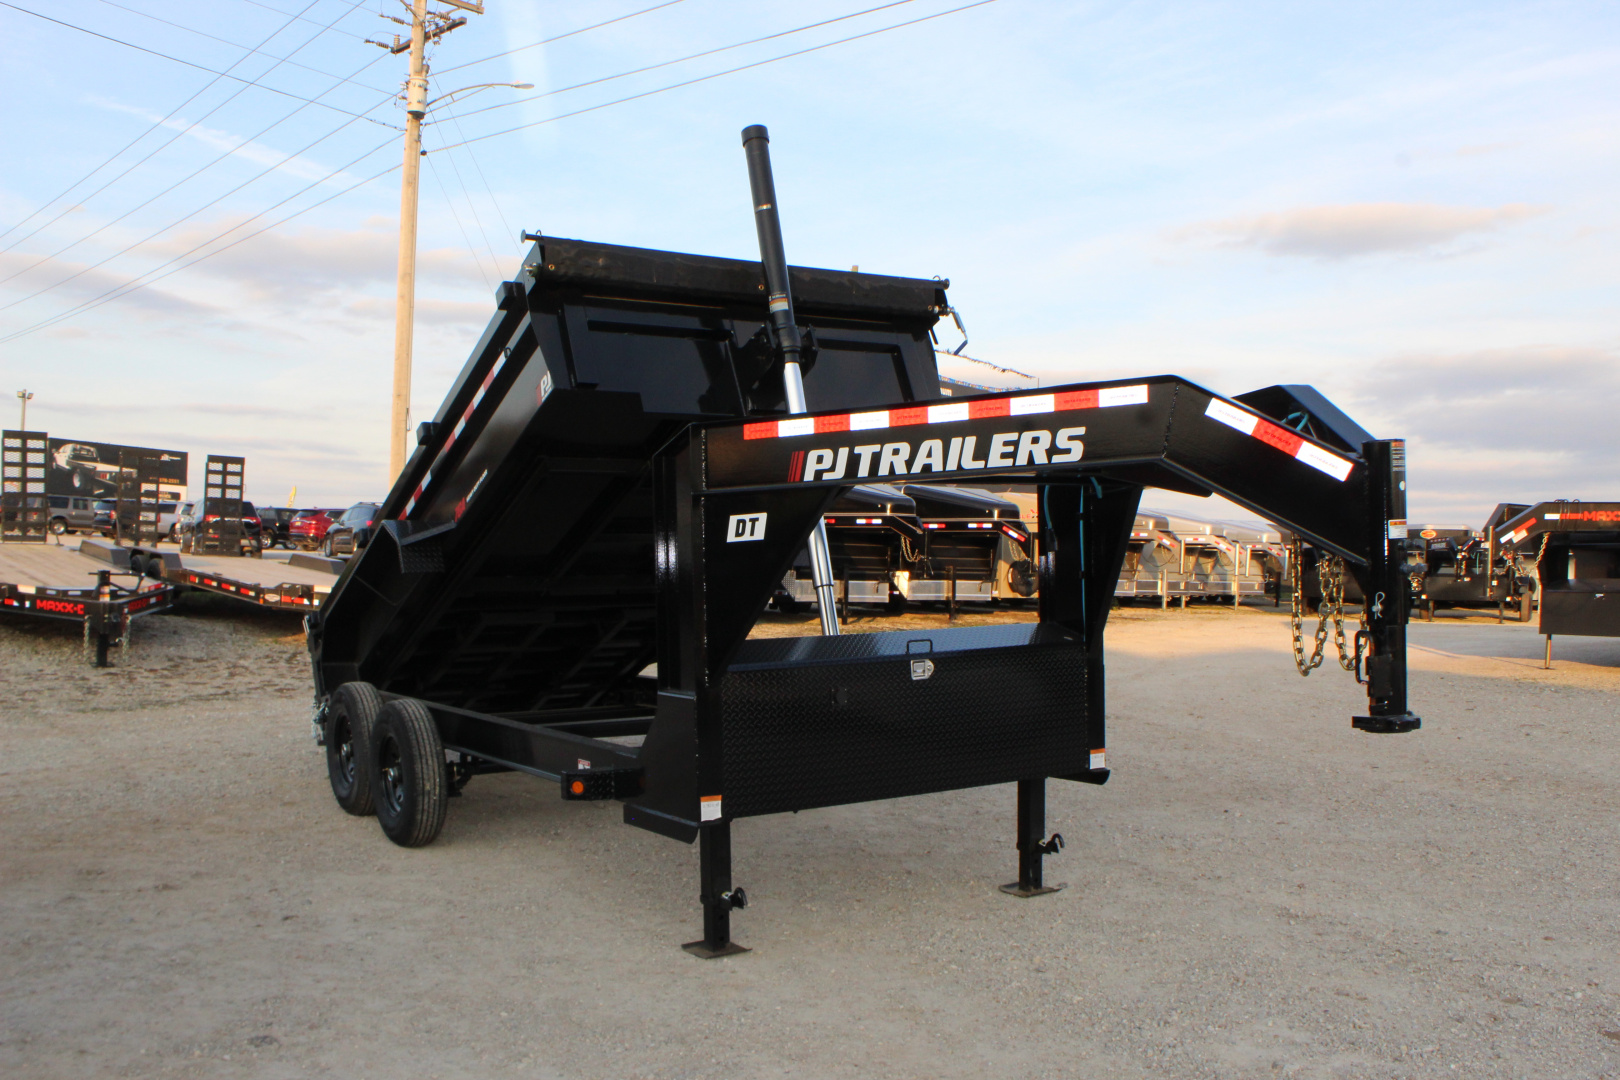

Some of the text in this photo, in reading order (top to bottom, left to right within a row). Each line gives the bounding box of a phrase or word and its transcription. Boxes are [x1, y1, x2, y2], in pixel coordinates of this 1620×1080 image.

[803, 426, 1087, 483] PJ TRAILERS
[734, 516, 760, 538] DT
[1583, 510, 1620, 522] MAX
